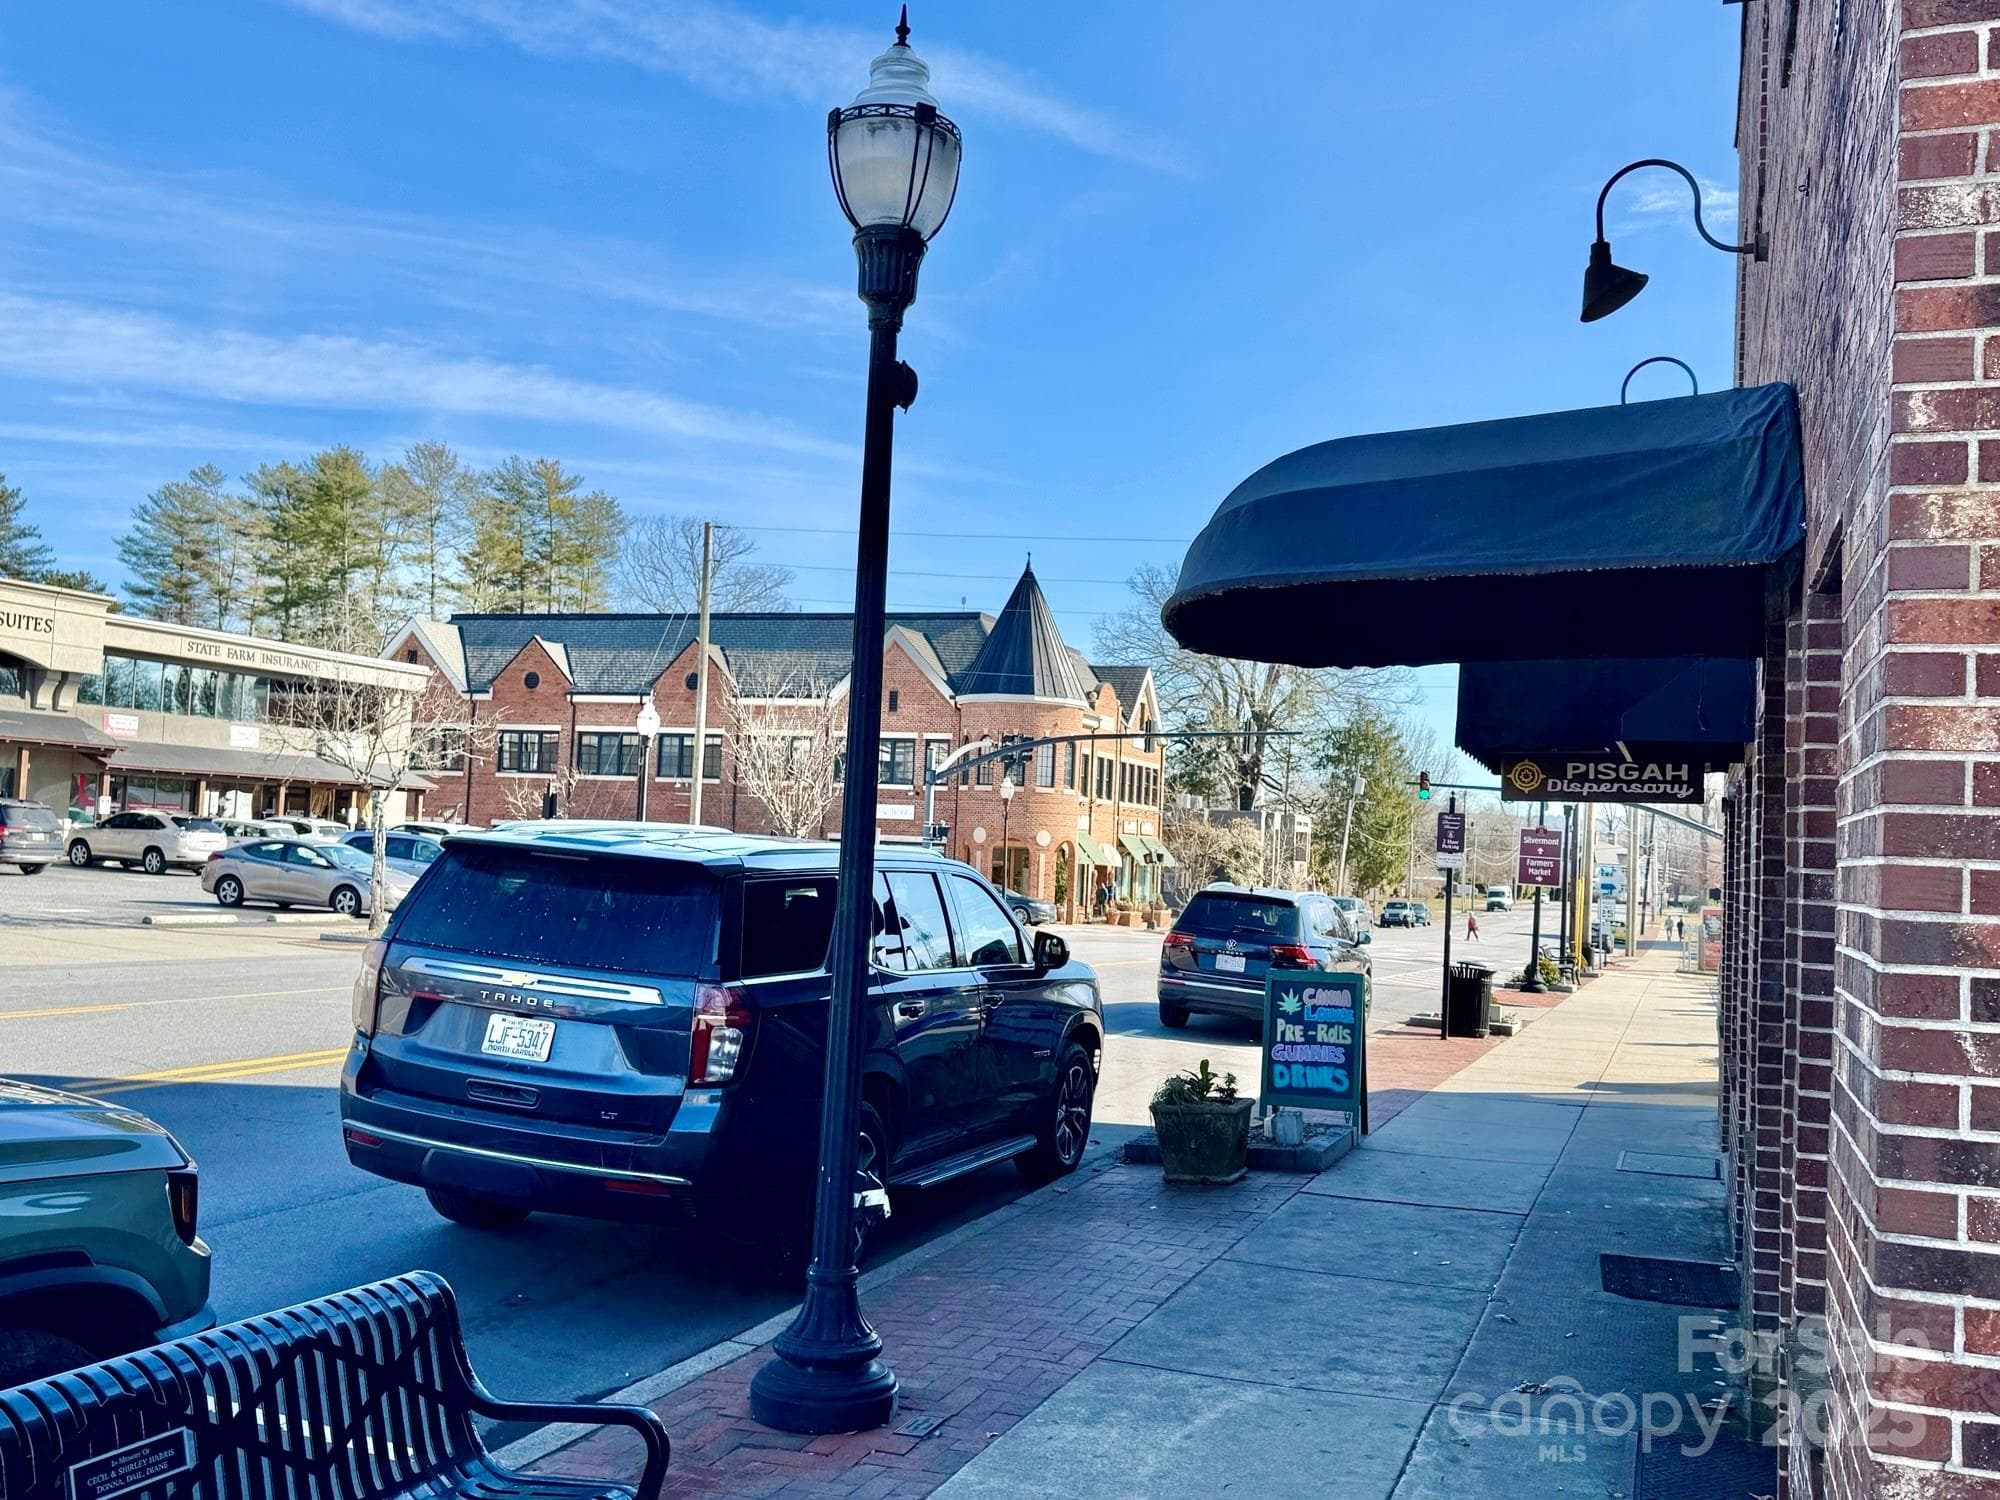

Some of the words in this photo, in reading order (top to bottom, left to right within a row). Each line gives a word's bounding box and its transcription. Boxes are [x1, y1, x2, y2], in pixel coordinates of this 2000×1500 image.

[187, 640, 221, 657] STATE
[227, 647, 256, 662] FARM
[261, 652, 321, 672] INSURANCE
[1566, 762, 1689, 781] PISGAH
[1546, 778, 1695, 798] Dispensary
[1523, 836, 1560, 846] Silvermont
[1526, 859, 1554, 868] Farmers
[1528, 867, 1552, 876] Market
[480, 990, 555, 1008] TAHOE
[1302, 988, 1352, 1007] CANNA
[488, 1023, 549, 1051] LJF-5347
[488, 1044, 510, 1053] NORTH
[511, 1048, 542, 1057] CAROLINA
[1271, 1043, 1346, 1064] GUMMIES
[1273, 1063, 1350, 1092] DRINKS
[601, 1111, 618, 1120] LT
[87, 1472, 110, 1487] CECIL
[110, 1470, 117, 1478] &
[118, 1458, 147, 1475] SHIRLEY
[148, 1448, 175, 1464] HARRIS
[146, 1461, 169, 1476] DIANE
